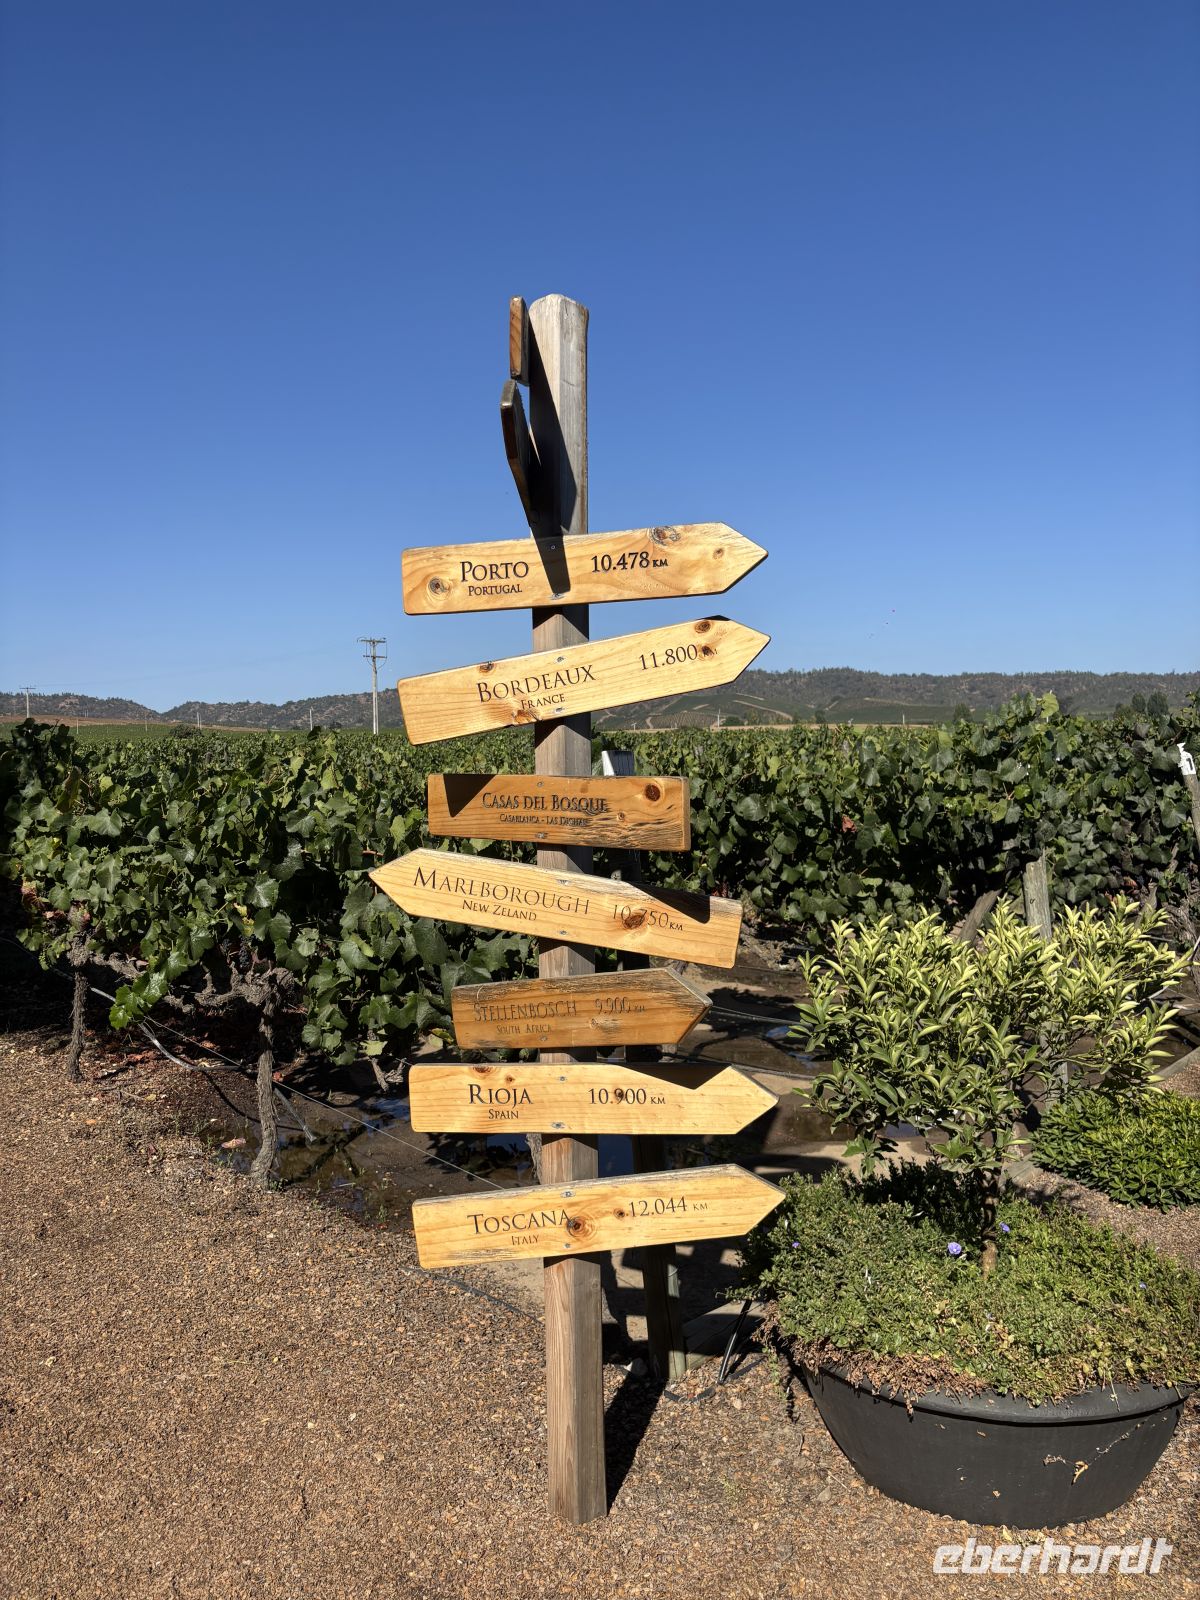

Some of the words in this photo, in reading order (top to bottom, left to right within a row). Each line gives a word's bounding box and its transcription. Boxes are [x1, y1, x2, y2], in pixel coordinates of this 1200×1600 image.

[460, 561, 529, 582] PORTO
[591, 551, 650, 572] 10.478
[652, 558, 669, 568] KM
[468, 584, 522, 596] PORTUGAL
[476, 665, 596, 703] BORDEAUX
[639, 644, 698, 670] 11.800
[521, 693, 565, 710] FRANCE
[482, 792, 519, 809] CASAS
[523, 795, 547, 811] DEL
[551, 795, 609, 816] BOSQUE
[413, 866, 590, 915] MARLBOROUGH
[613, 904, 669, 928] 10750
[669, 922, 683, 931] KM
[462, 899, 490, 913] NEW
[493, 904, 537, 921] ZELAND
[473, 1000, 577, 1023] STELLENBOSCH
[595, 997, 631, 1014] 9.900
[496, 1023, 520, 1034] SOUTH
[526, 1023, 551, 1034] AFRICA
[468, 1084, 534, 1109] RIOJA
[588, 1088, 647, 1104] 10.900
[488, 1109, 519, 1119] SPAIN
[467, 1209, 570, 1235] TOSCANA
[629, 1195, 687, 1217] 12.044
[692, 1203, 708, 1211] KM
[511, 1235, 539, 1246] ITALY
